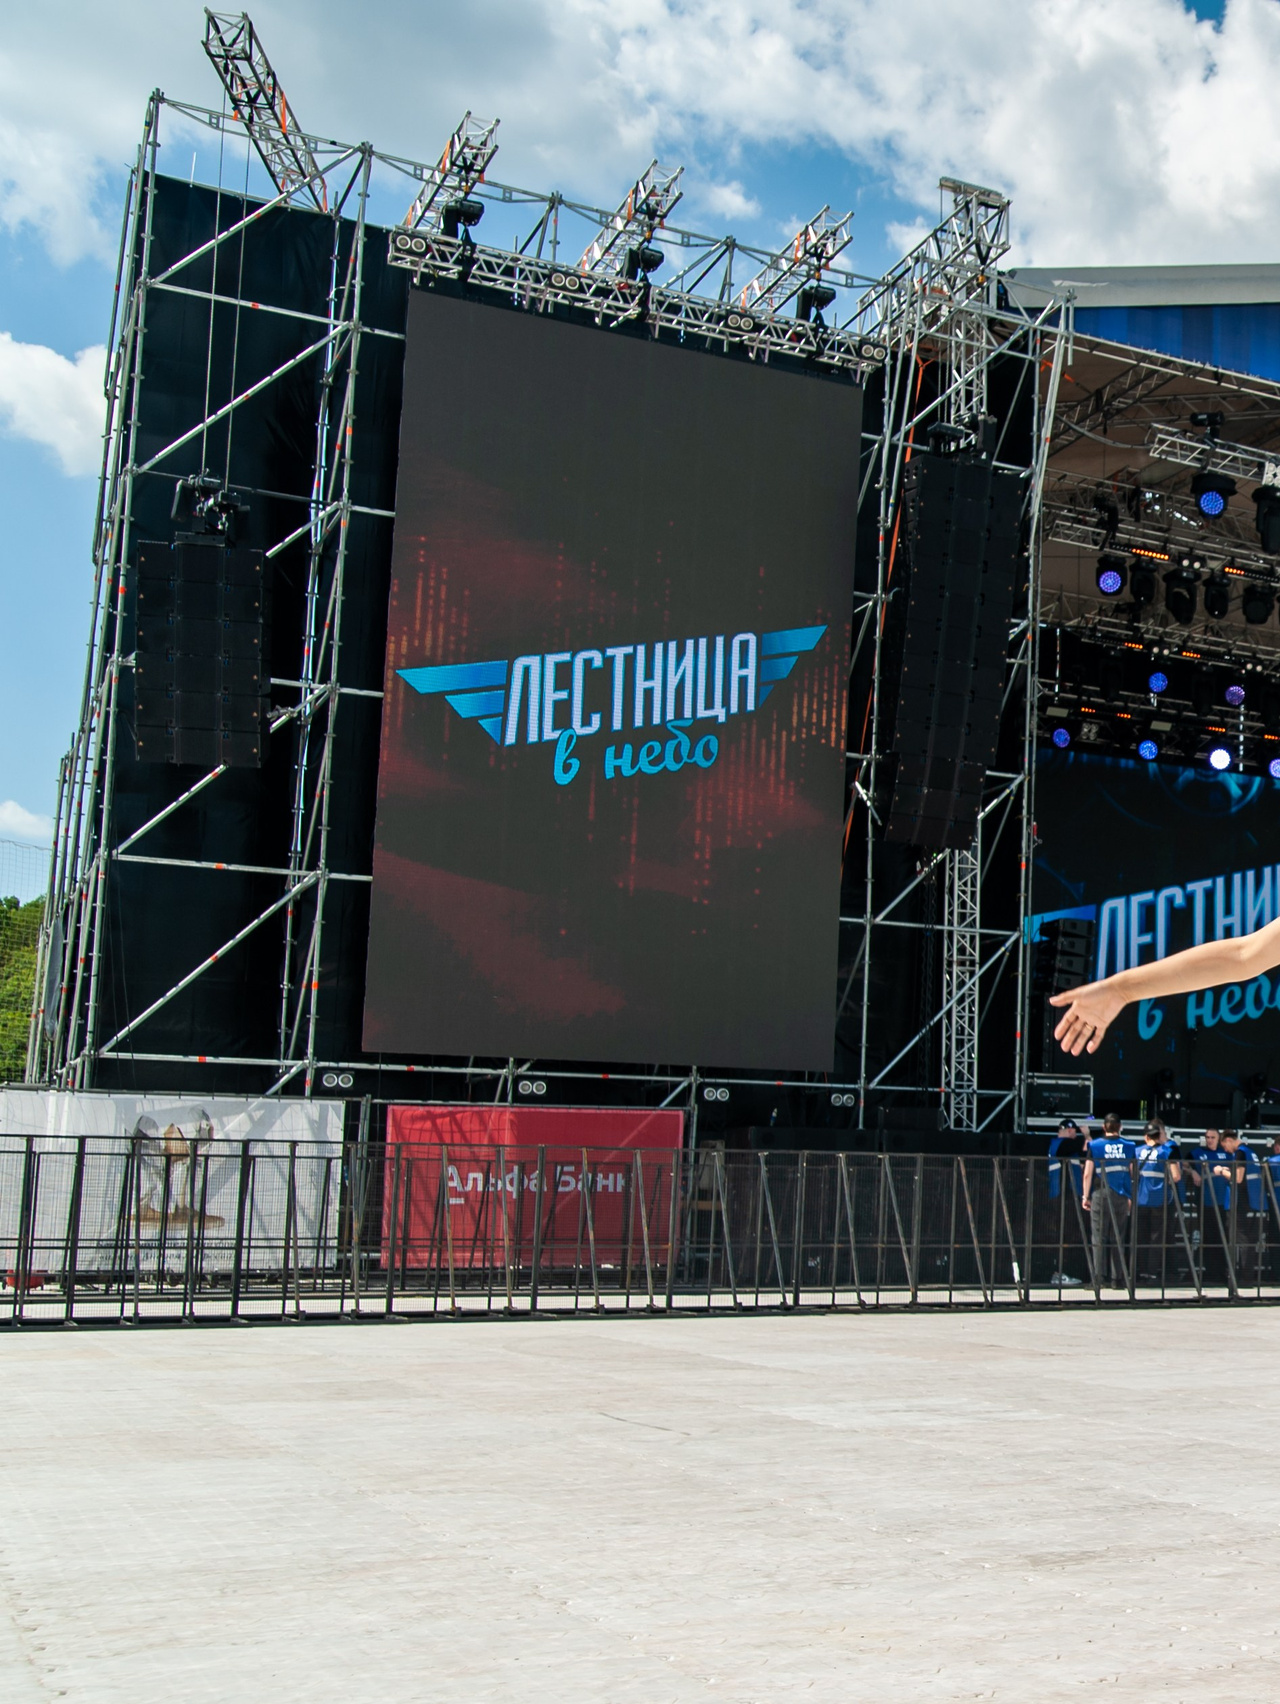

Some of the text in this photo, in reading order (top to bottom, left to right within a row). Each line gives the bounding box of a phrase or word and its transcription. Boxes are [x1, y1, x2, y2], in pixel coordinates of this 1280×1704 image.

[503, 632, 758, 747] ЛЕСТНИЦА
[553, 719, 719, 786] в небо
[446, 1164, 635, 1199] Альфа Банк
